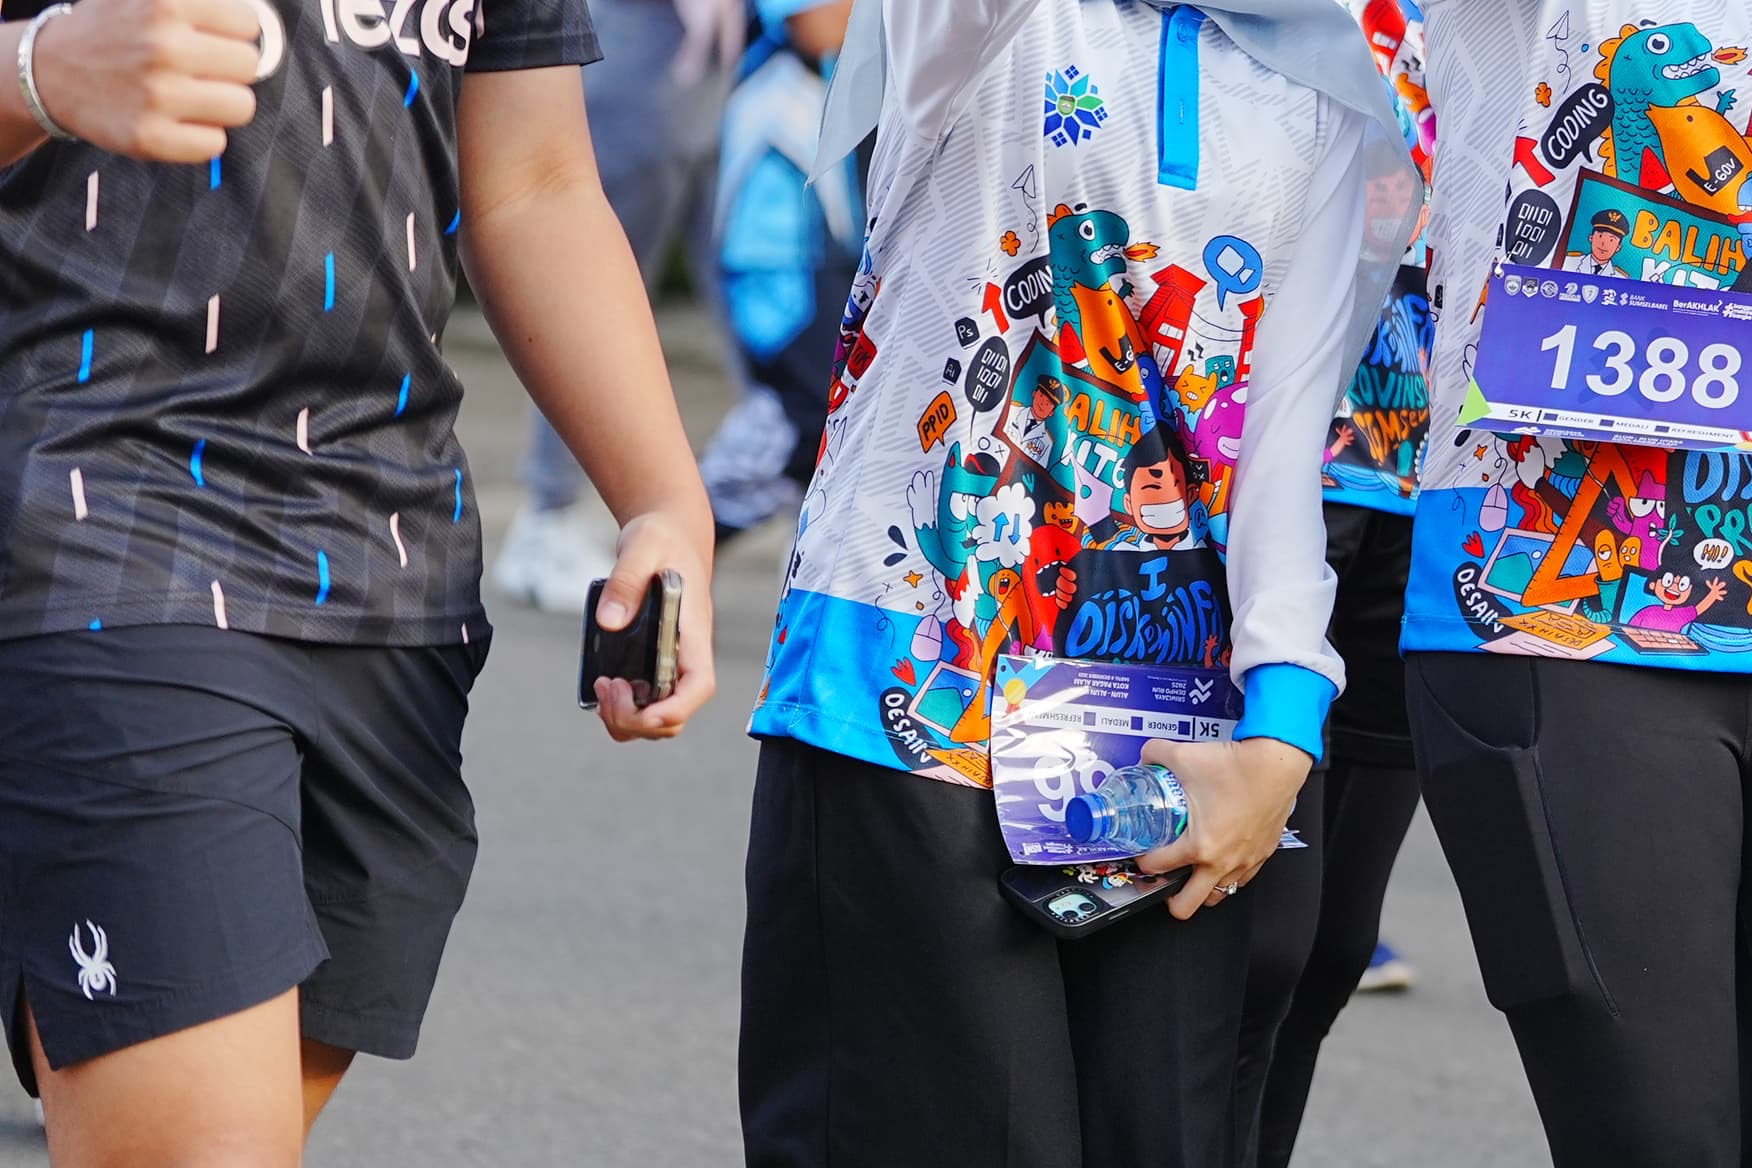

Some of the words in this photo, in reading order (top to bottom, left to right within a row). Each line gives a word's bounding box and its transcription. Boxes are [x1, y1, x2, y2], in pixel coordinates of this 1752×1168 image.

[1547, 88, 1609, 161] CODING
[1631, 209, 1748, 275] BALIH
[1006, 264, 1054, 312] CODIN
[957, 324, 974, 340] Ps
[1540, 324, 1743, 410] 1388
[922, 401, 950, 441] PPID
[1112, 682, 1130, 690] KOTA
[1101, 717, 1130, 728] MEDALI
[1147, 720, 1178, 733] GENDER
[1200, 721, 1220, 738] 5K
